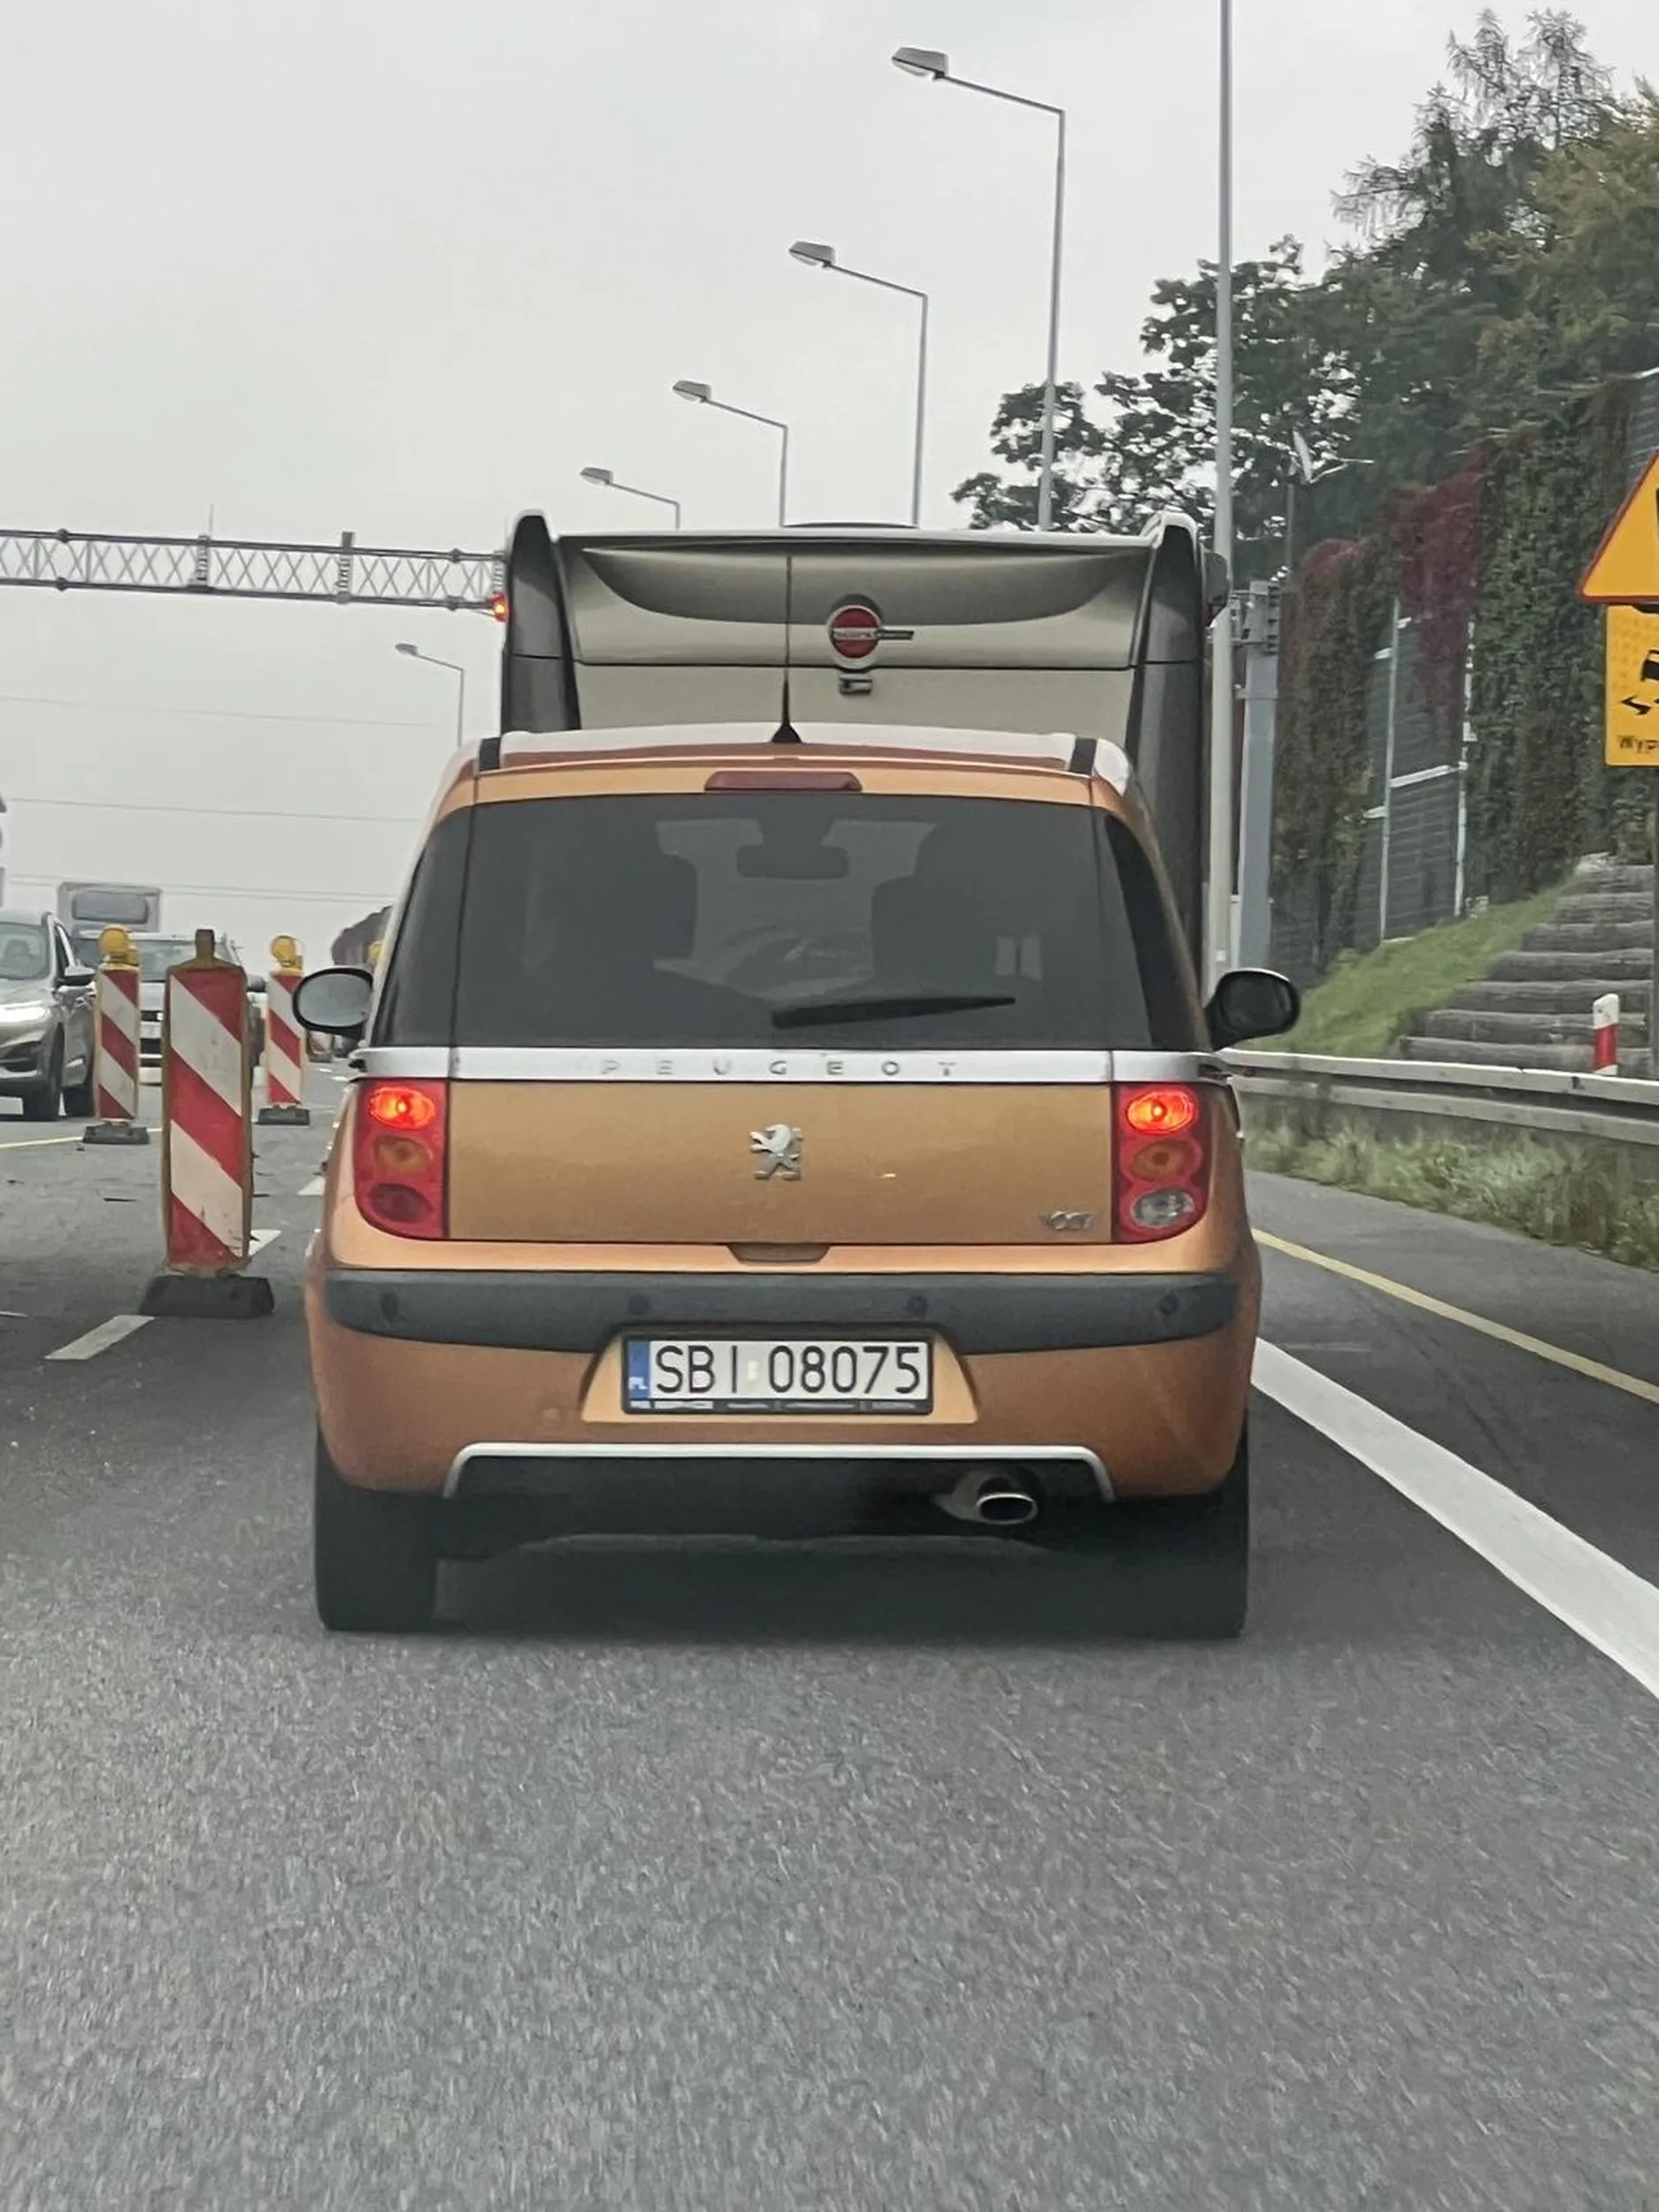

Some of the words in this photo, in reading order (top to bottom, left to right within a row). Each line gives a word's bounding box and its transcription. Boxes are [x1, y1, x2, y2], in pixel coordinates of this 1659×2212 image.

[600, 1059, 958, 1077] PEUGEOT
[656, 1345, 738, 1394] SBI
[768, 1345, 921, 1394] 08075
